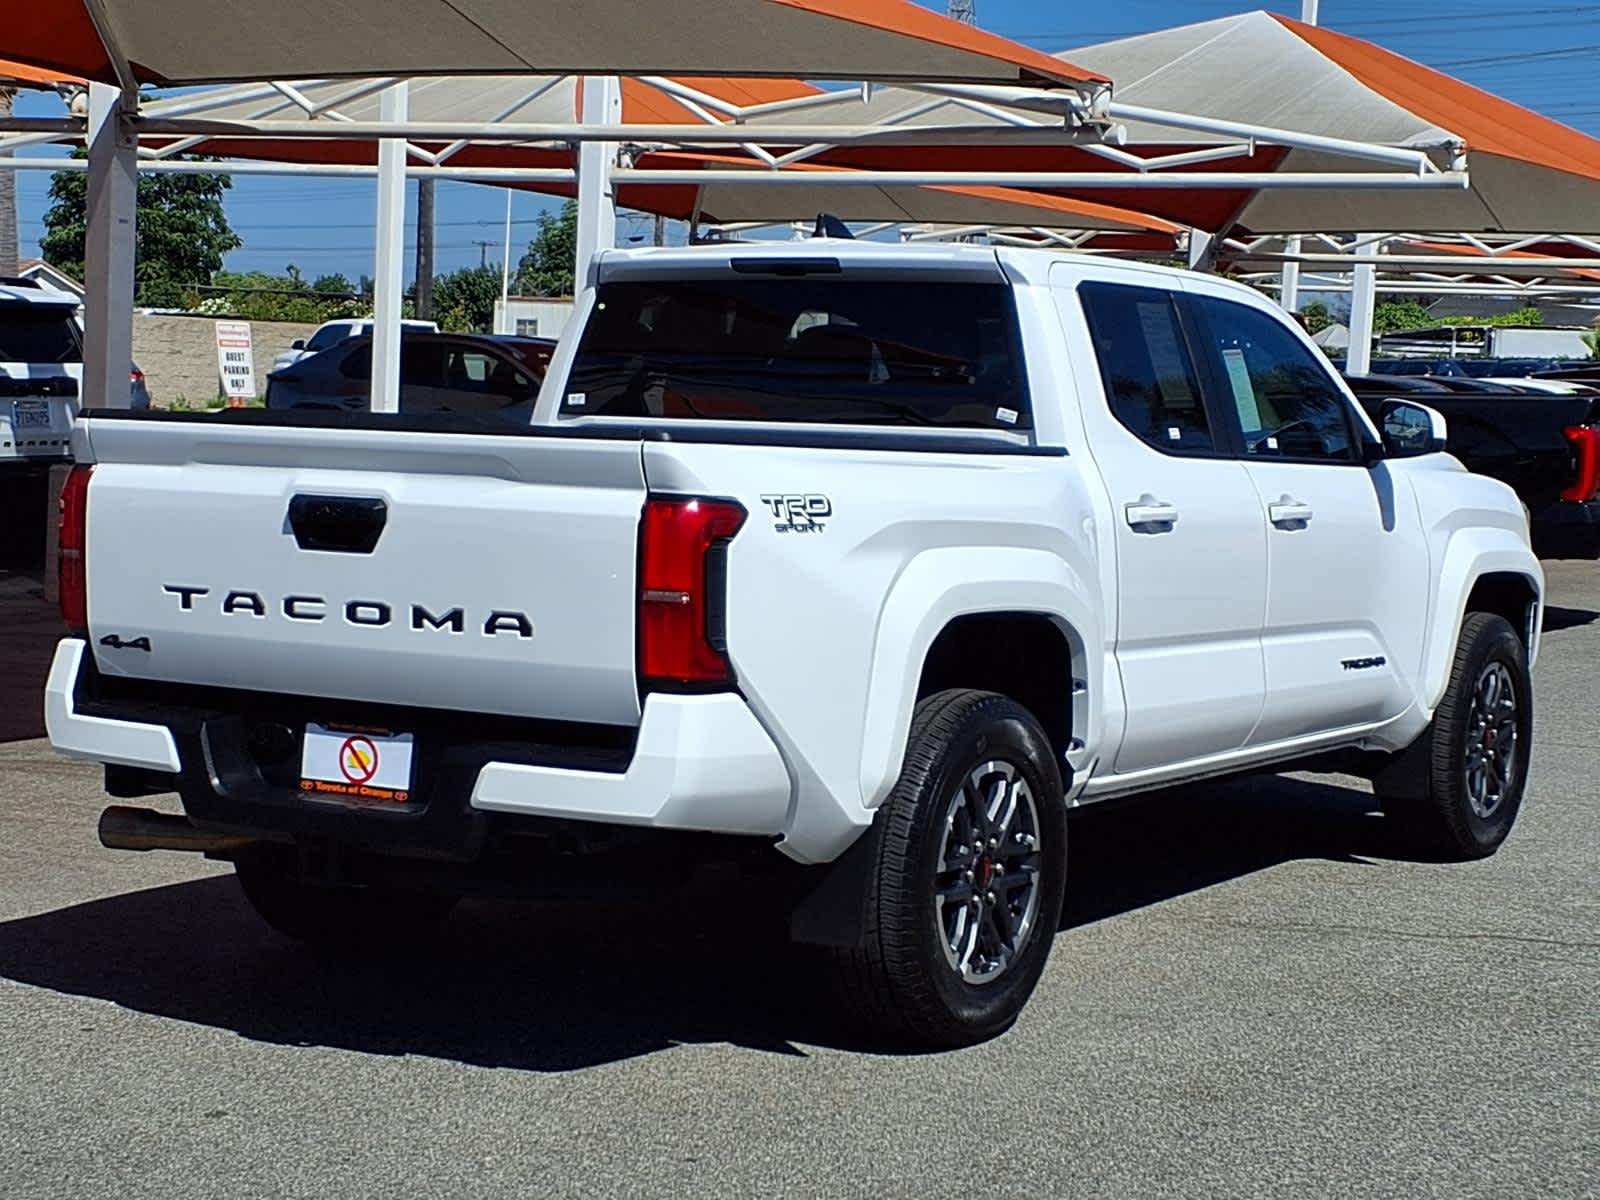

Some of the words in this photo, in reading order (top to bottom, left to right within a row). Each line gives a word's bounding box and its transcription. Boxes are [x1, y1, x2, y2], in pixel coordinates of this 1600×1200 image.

[225, 351, 245, 361] GUEST
[223, 365, 250, 375] PARKING
[230, 379, 245, 388] ONLY
[760, 493, 832, 526] TRD
[774, 523, 826, 533] SPORT
[163, 584, 534, 638] TACOMA
[315, 781, 346, 794] Toyota
[347, 785, 359, 794] of
